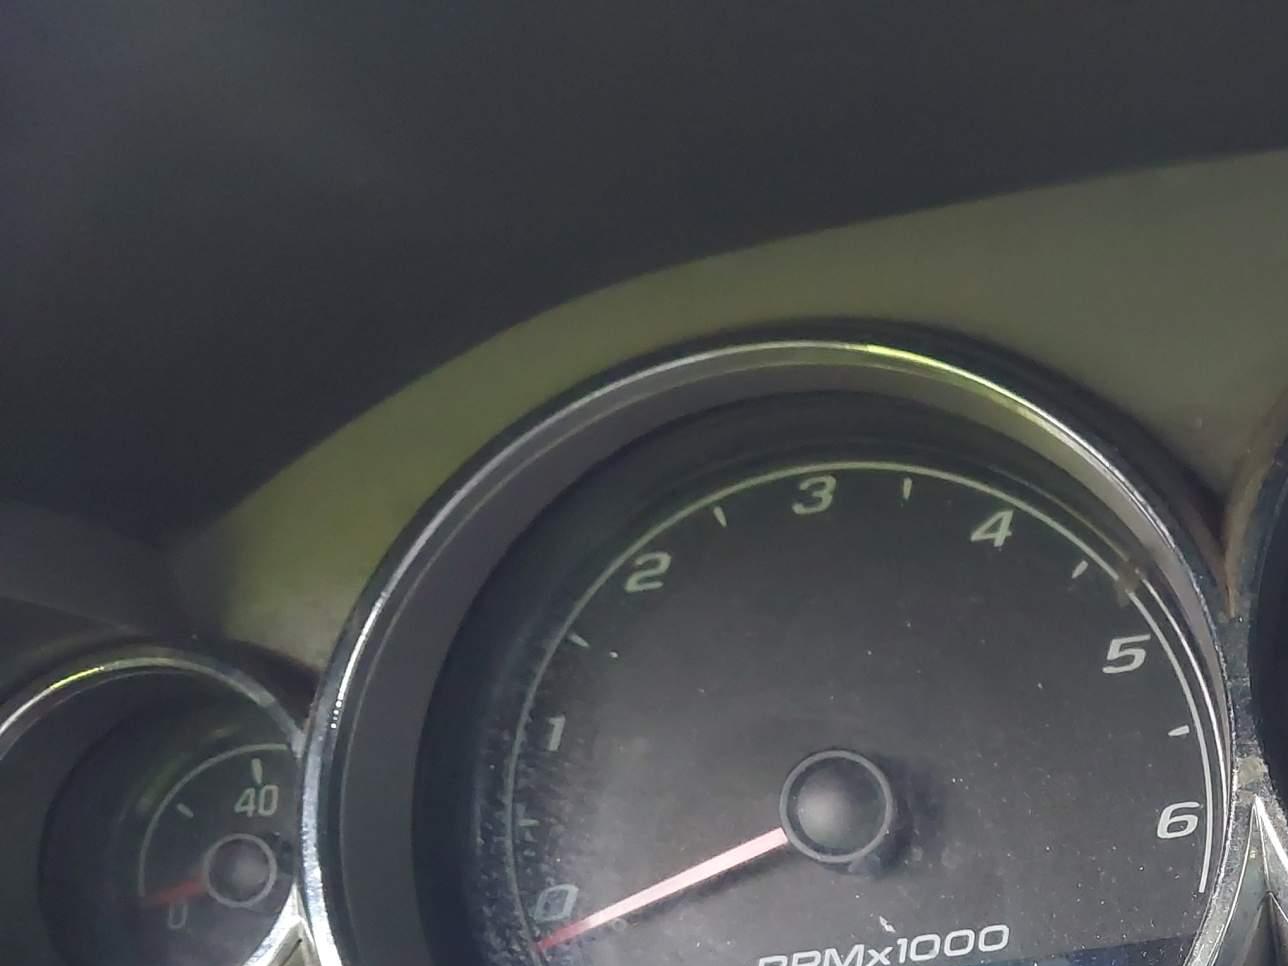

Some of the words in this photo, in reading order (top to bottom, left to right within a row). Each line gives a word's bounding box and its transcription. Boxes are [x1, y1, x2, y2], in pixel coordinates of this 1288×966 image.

[791, 476, 837, 515] 3
[970, 509, 1014, 547] 4
[625, 552, 672, 592] 2
[1102, 634, 1150, 674] 5
[545, 716, 566, 750] 1
[234, 785, 278, 816] 40
[1156, 802, 1199, 839] 6
[533, 884, 578, 920] 0
